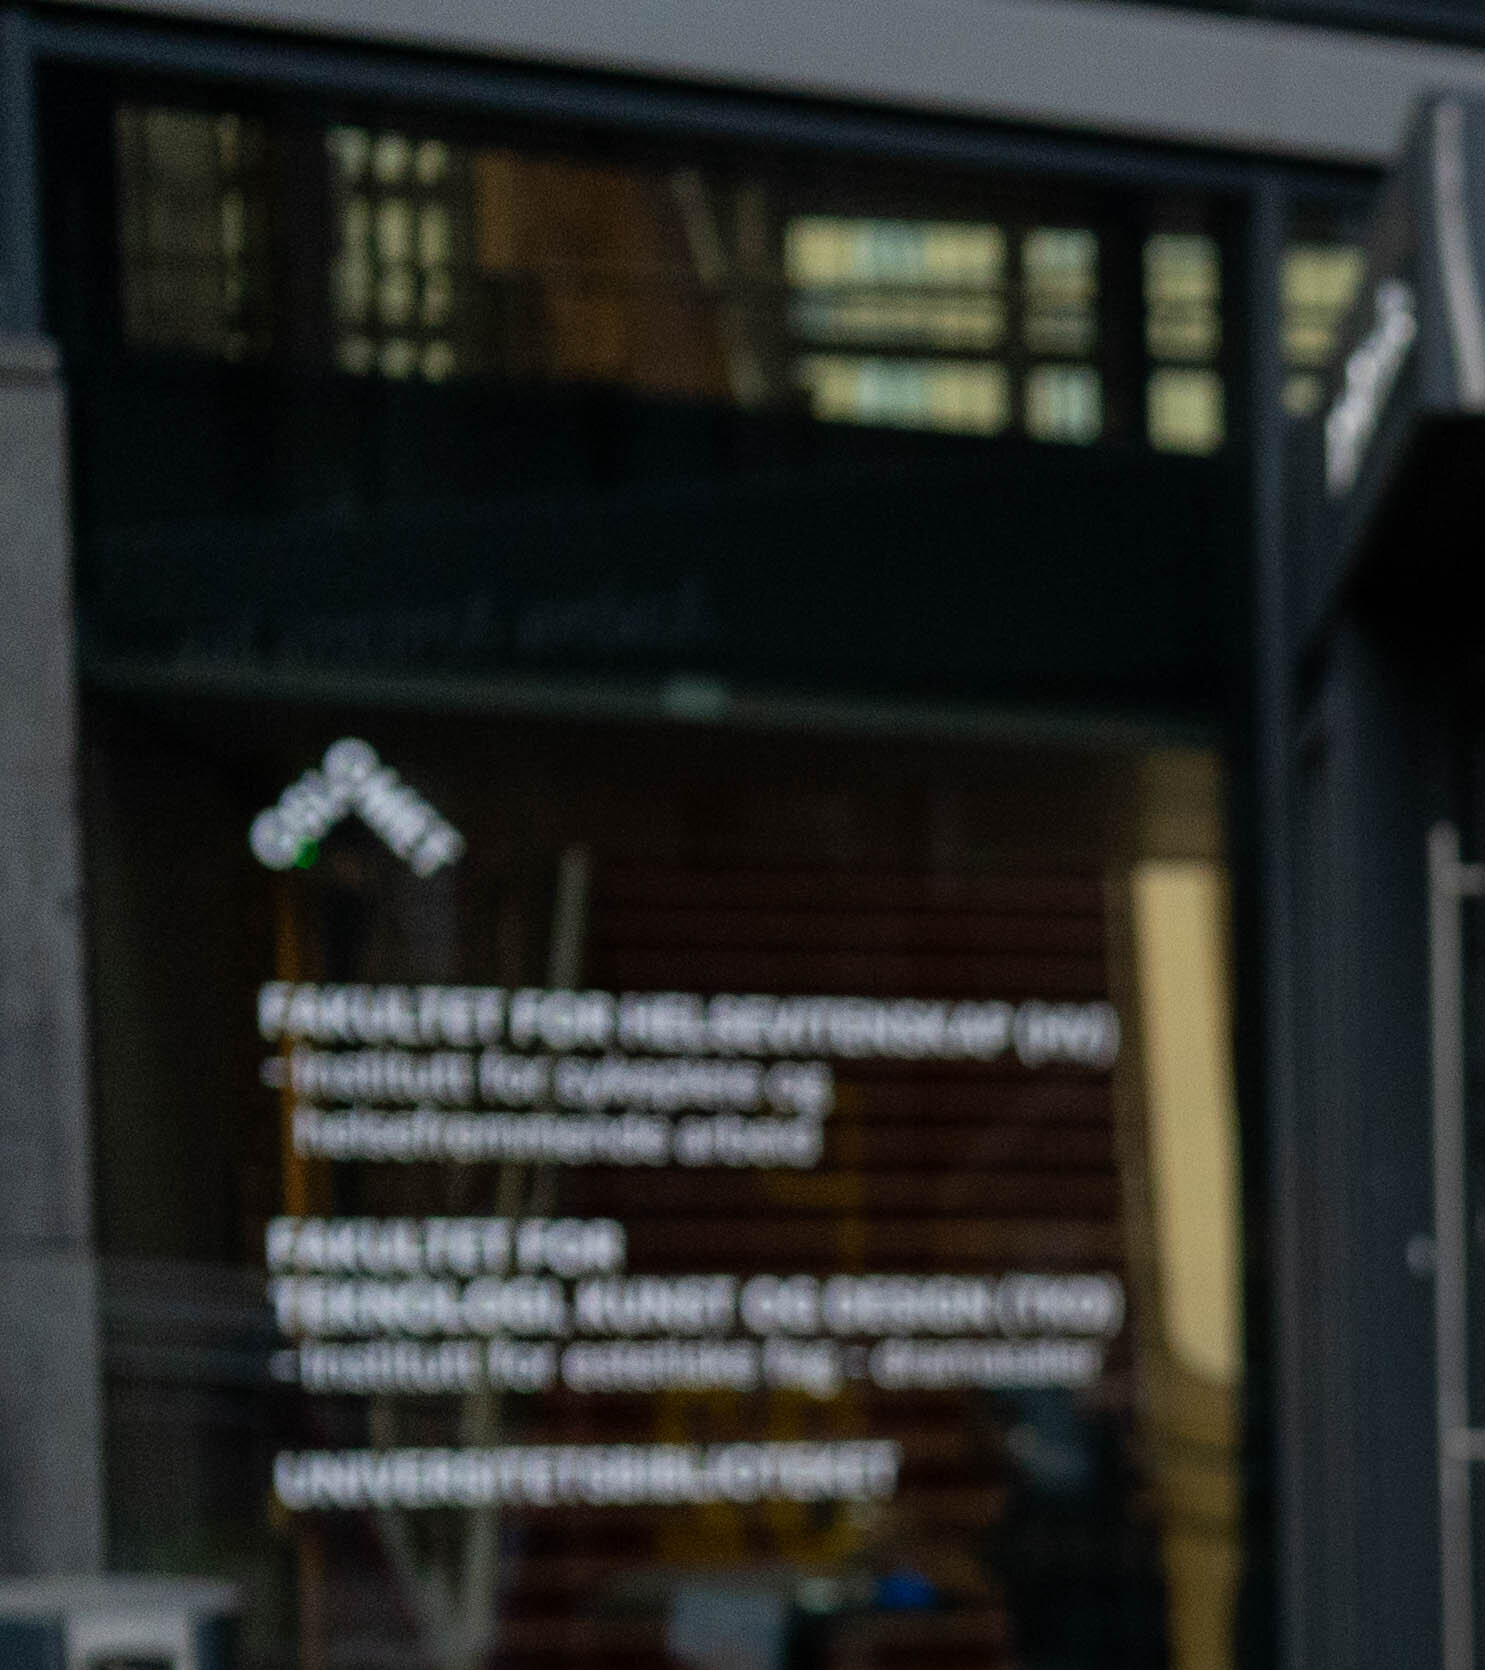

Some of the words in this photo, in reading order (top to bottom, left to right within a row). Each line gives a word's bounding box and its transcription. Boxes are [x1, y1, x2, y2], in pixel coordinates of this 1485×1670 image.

[261, 985, 502, 1042] FAKULTET
[513, 991, 609, 1047] FOR
[268, 1220, 508, 1272] FAKULTET
[519, 1222, 622, 1272] FOR
[577, 1278, 733, 1334] KUNST
[743, 1277, 816, 1334] OG
